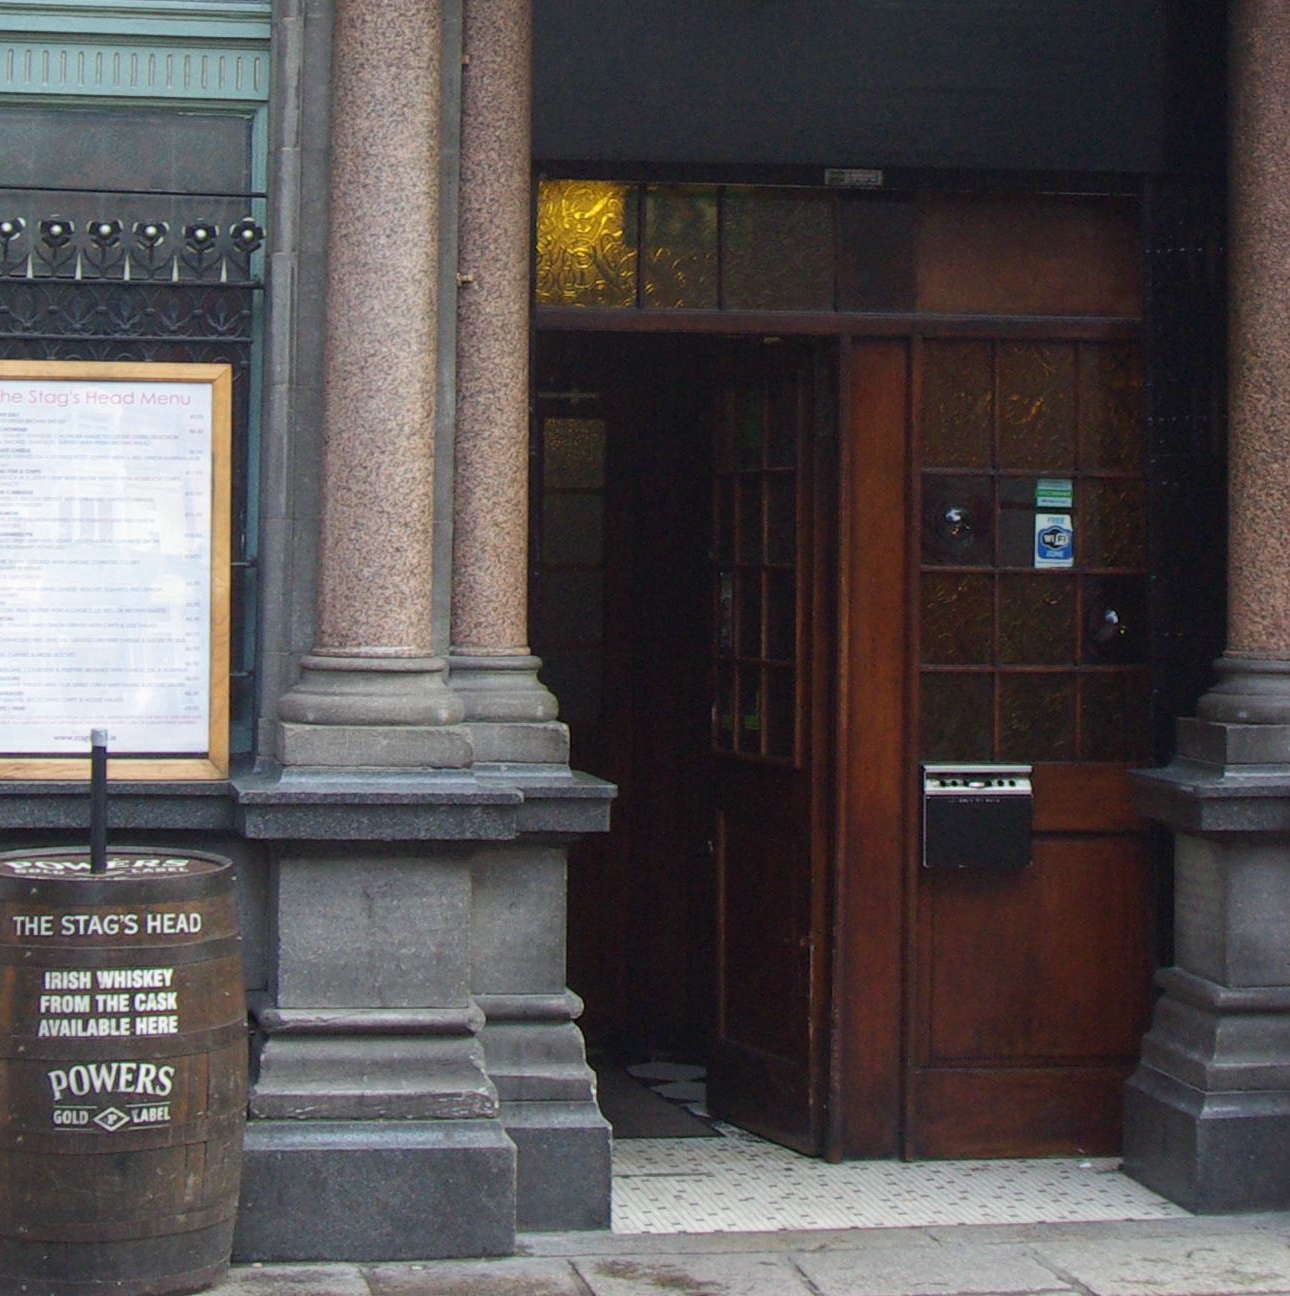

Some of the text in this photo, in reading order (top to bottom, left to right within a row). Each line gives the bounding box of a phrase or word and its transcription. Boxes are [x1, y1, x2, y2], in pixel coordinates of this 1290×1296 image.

[28, 389, 80, 407] Stag's
[85, 390, 135, 405] Head
[140, 392, 191, 406] Menu
[13, 912, 203, 937] THE STAG'S HEAD
[44, 968, 174, 990] IRISH WHISKEY
[40, 991, 178, 1014] FROM THE CASK
[37, 1016, 179, 1038] AVAILABLE HERE
[47, 1061, 176, 1101] POWERS
[53, 1108, 89, 1127] GOLD
[132, 1106, 172, 1124] LABEL
